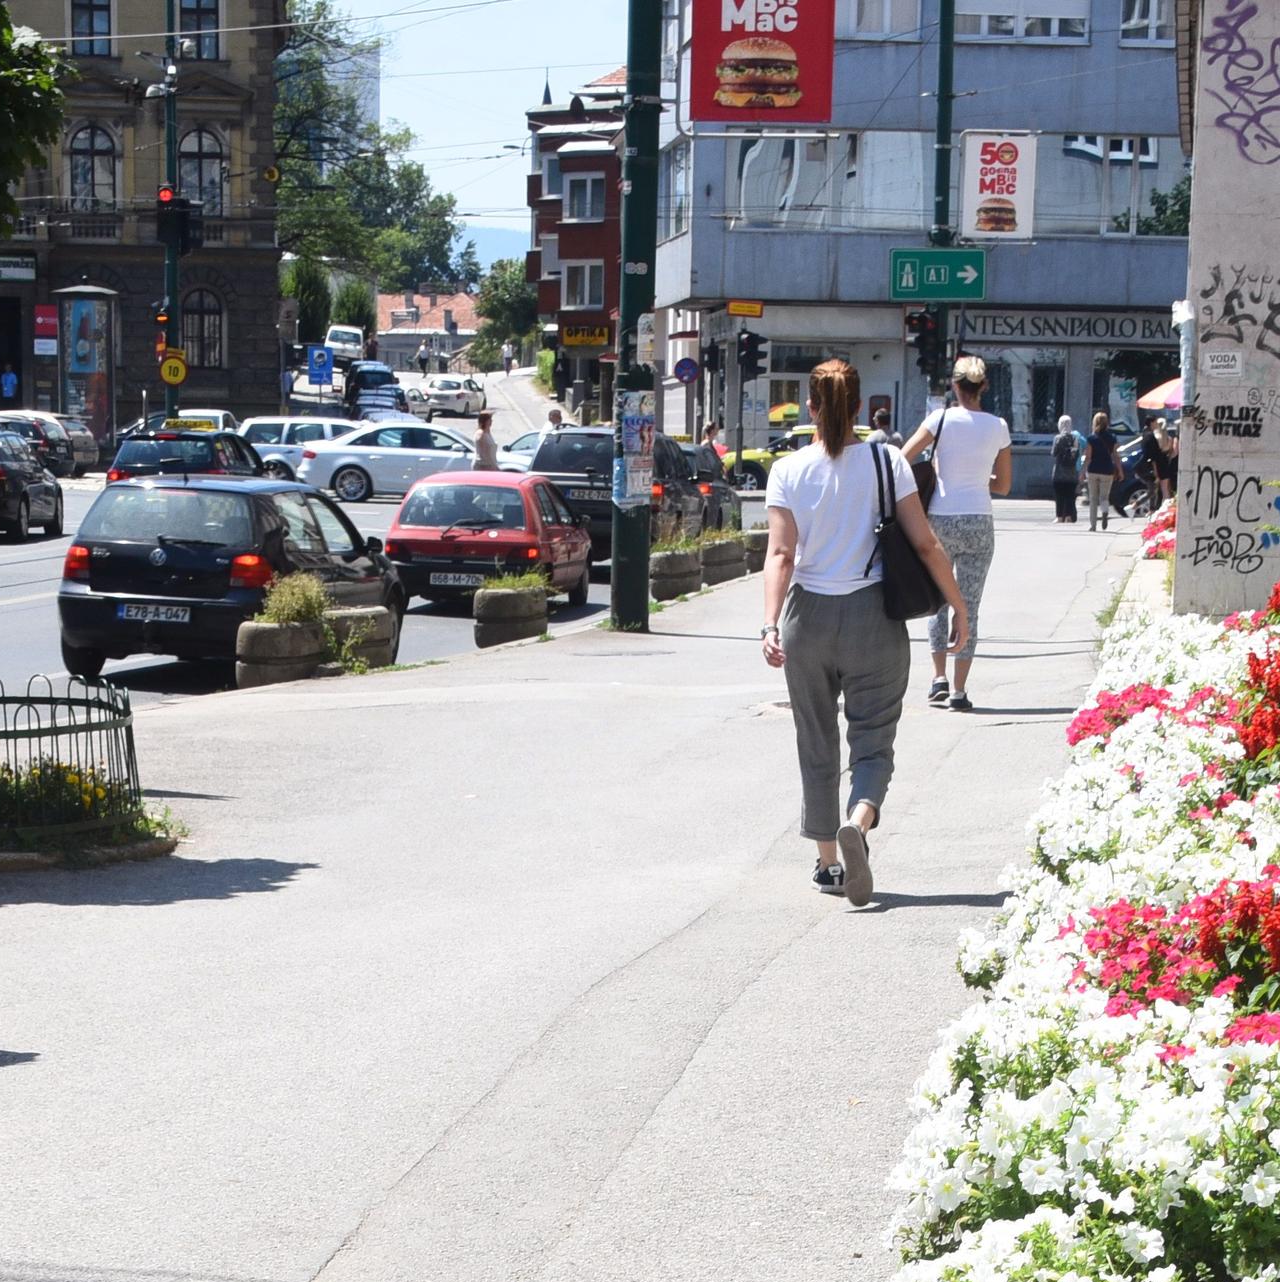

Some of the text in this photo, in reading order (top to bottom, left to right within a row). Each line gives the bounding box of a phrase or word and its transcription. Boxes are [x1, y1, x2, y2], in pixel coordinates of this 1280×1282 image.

[980, 142, 1019, 166] 50
[566, 325, 607, 338] OPTIKA
[953, 314, 1025, 336] INTESA
[1029, 316, 1137, 339] SANPAOLO
[1209, 354, 1238, 363] VODA
[168, 365, 180, 378] 10
[1212, 422, 1263, 438] OTKAZ
[125, 605, 189, 622] E78-A-047
